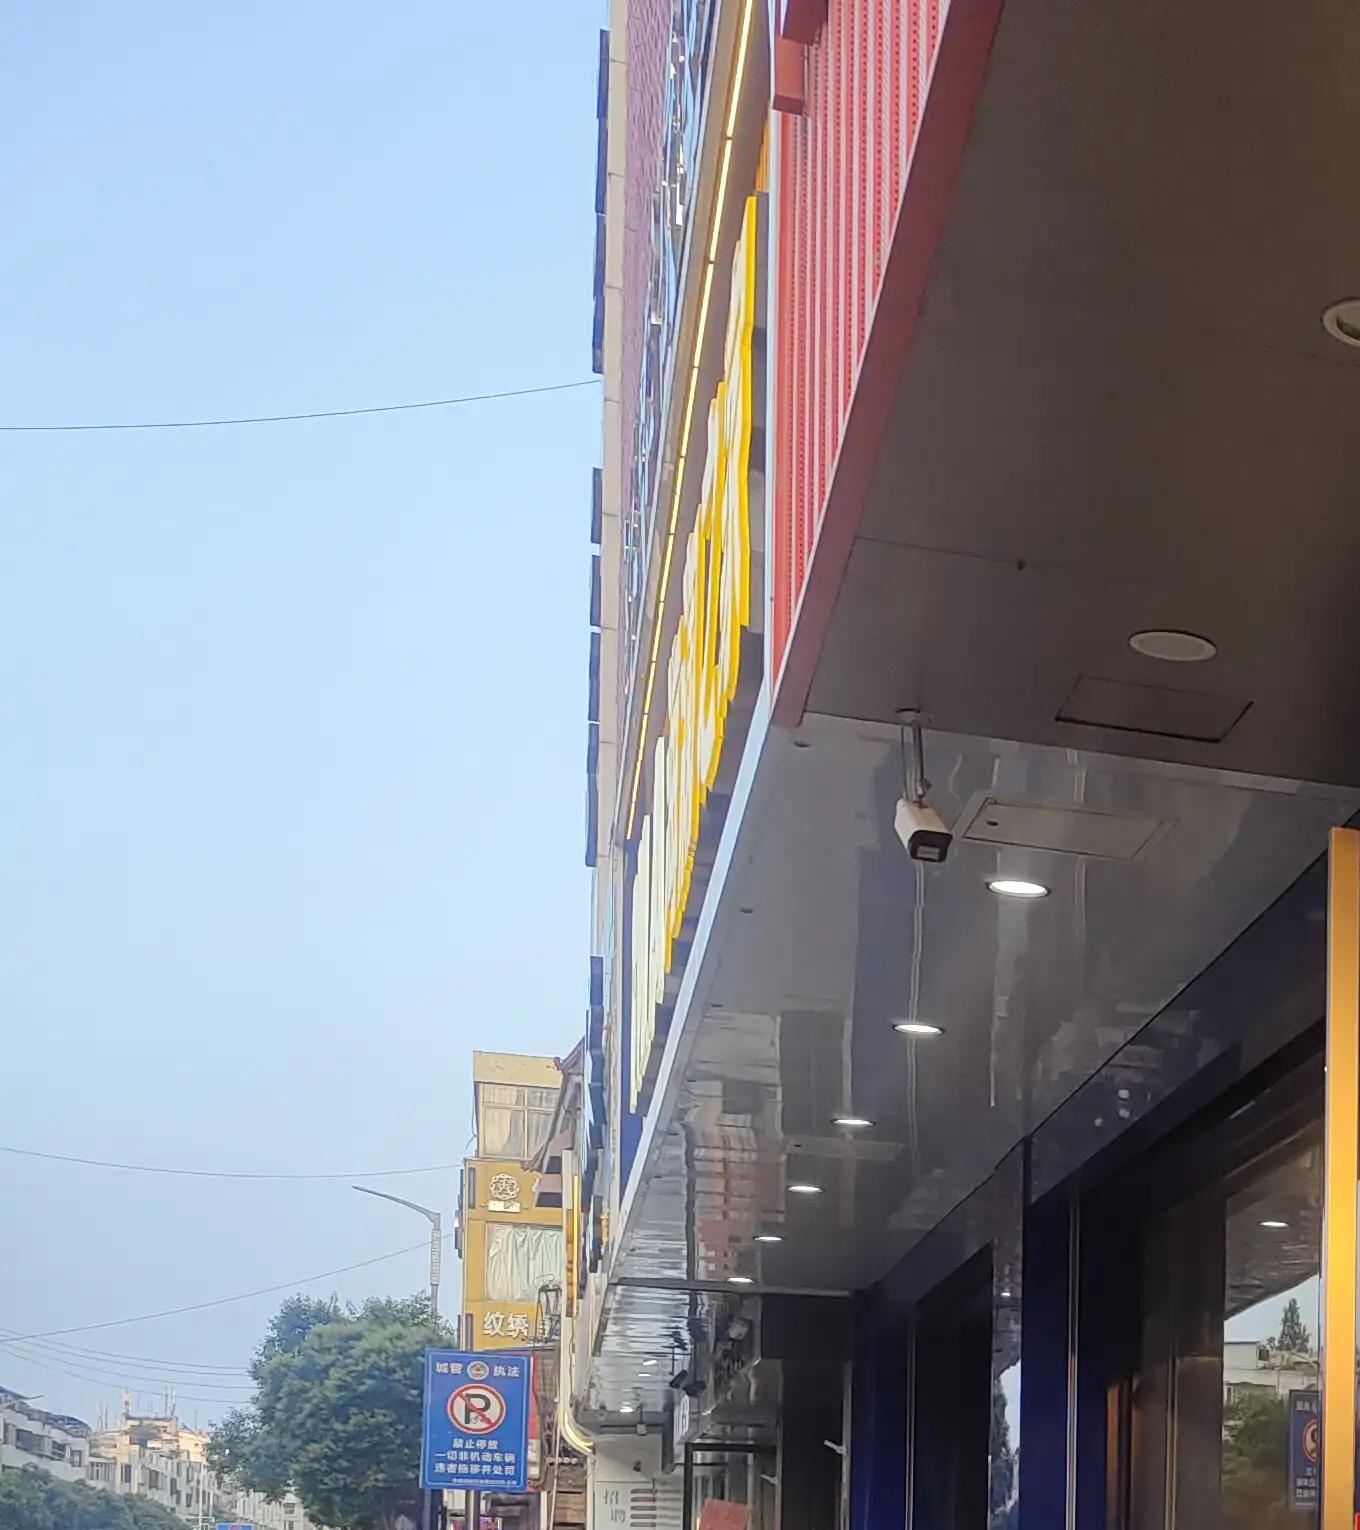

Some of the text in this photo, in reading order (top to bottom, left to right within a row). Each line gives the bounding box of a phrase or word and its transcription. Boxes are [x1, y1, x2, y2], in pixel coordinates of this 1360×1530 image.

[453, 1438, 499, 1450] 禁止停放
[434, 1451, 515, 1463] 一切非机动车辆
